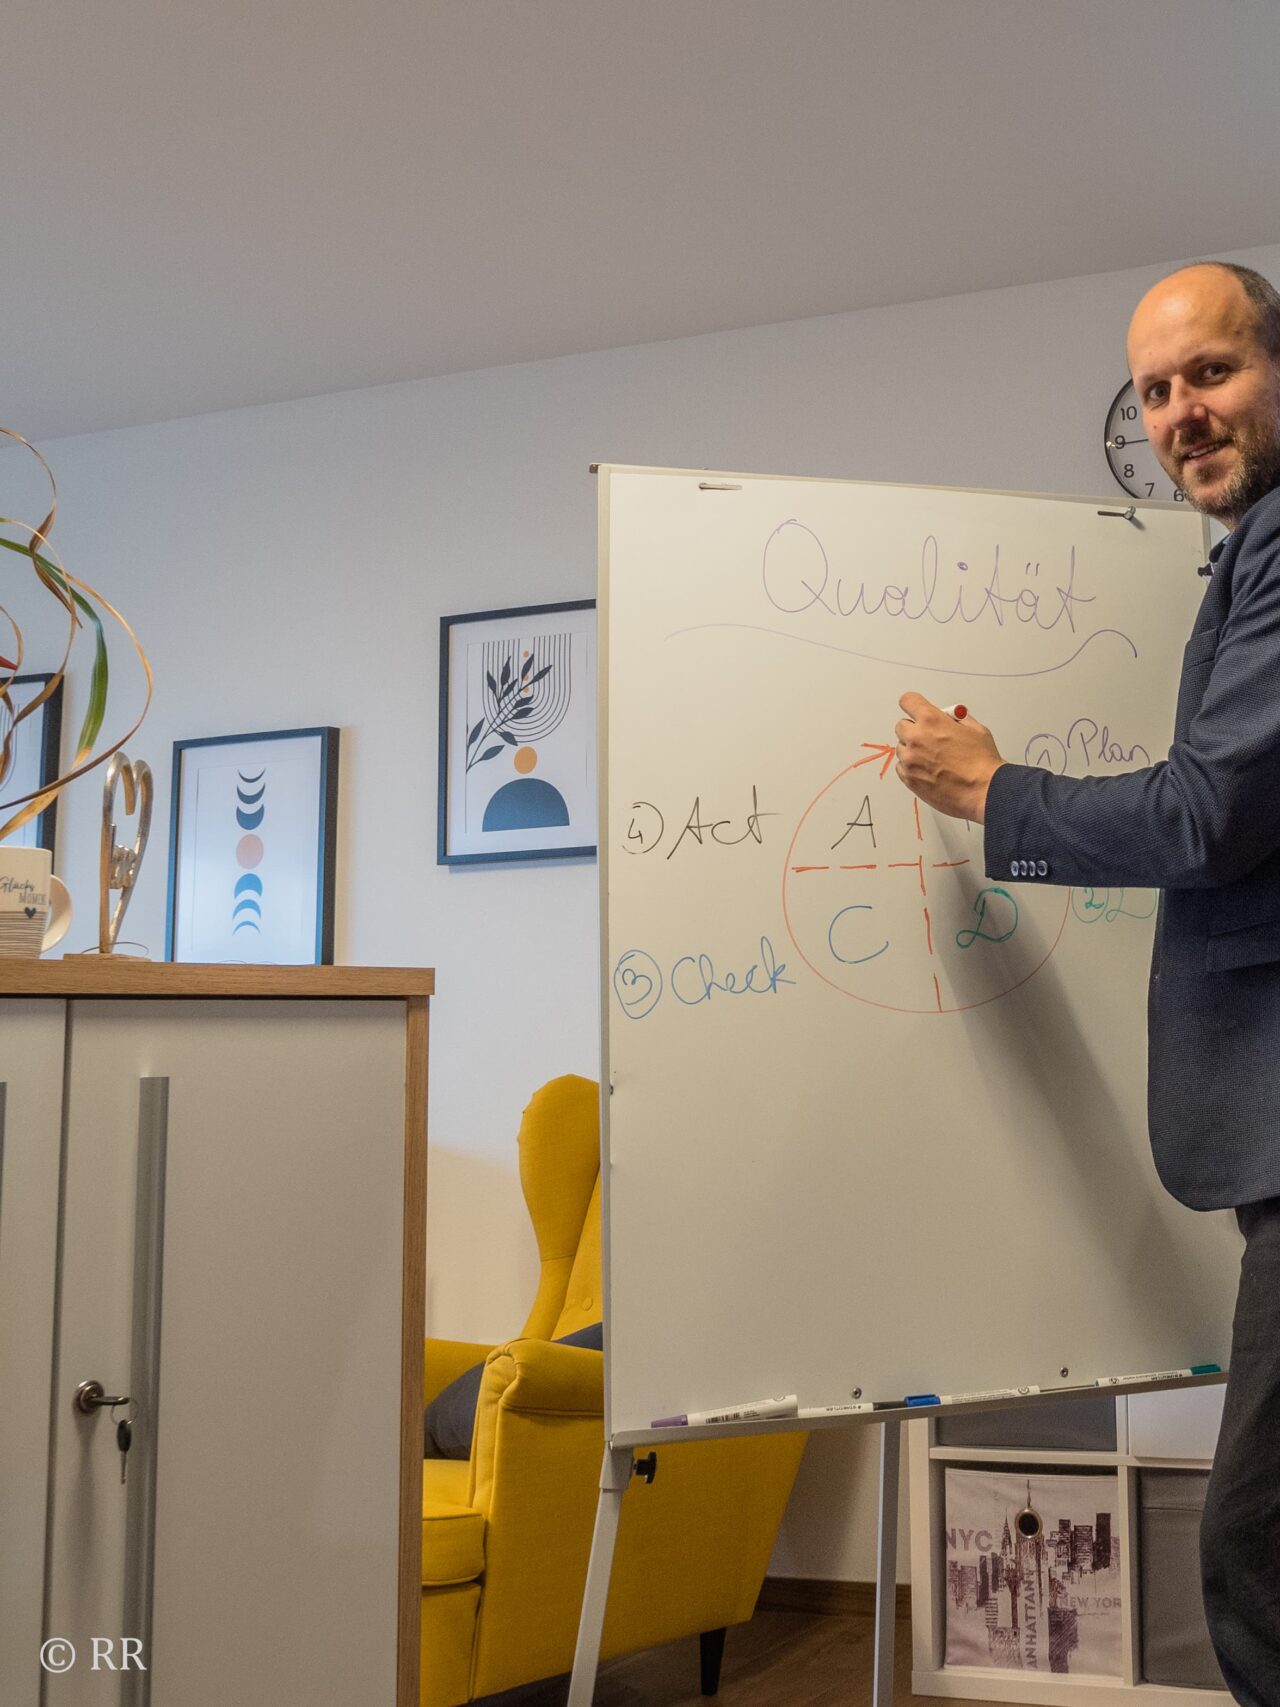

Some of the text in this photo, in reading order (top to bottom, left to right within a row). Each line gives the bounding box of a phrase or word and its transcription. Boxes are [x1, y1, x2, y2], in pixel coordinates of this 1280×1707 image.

[1120, 406, 1137, 421] 10
[1114, 435, 1126, 449] 9
[1124, 464, 1134, 478] 8
[1145, 483, 1154, 496] 7
[1174, 488, 1184, 502] 6
[762, 519, 1096, 632] Qualität
[1066, 718, 1150, 766] Plan
[667, 785, 781, 859] Act
[831, 795, 876, 849] A
[829, 906, 888, 964] C
[956, 888, 1018, 948] D
[672, 937, 796, 1004] Check
[946, 1528, 993, 1552] NYC
[1024, 1577, 1038, 1668] ANHATTAN
[1093, 1597, 1121, 1608] YOR
